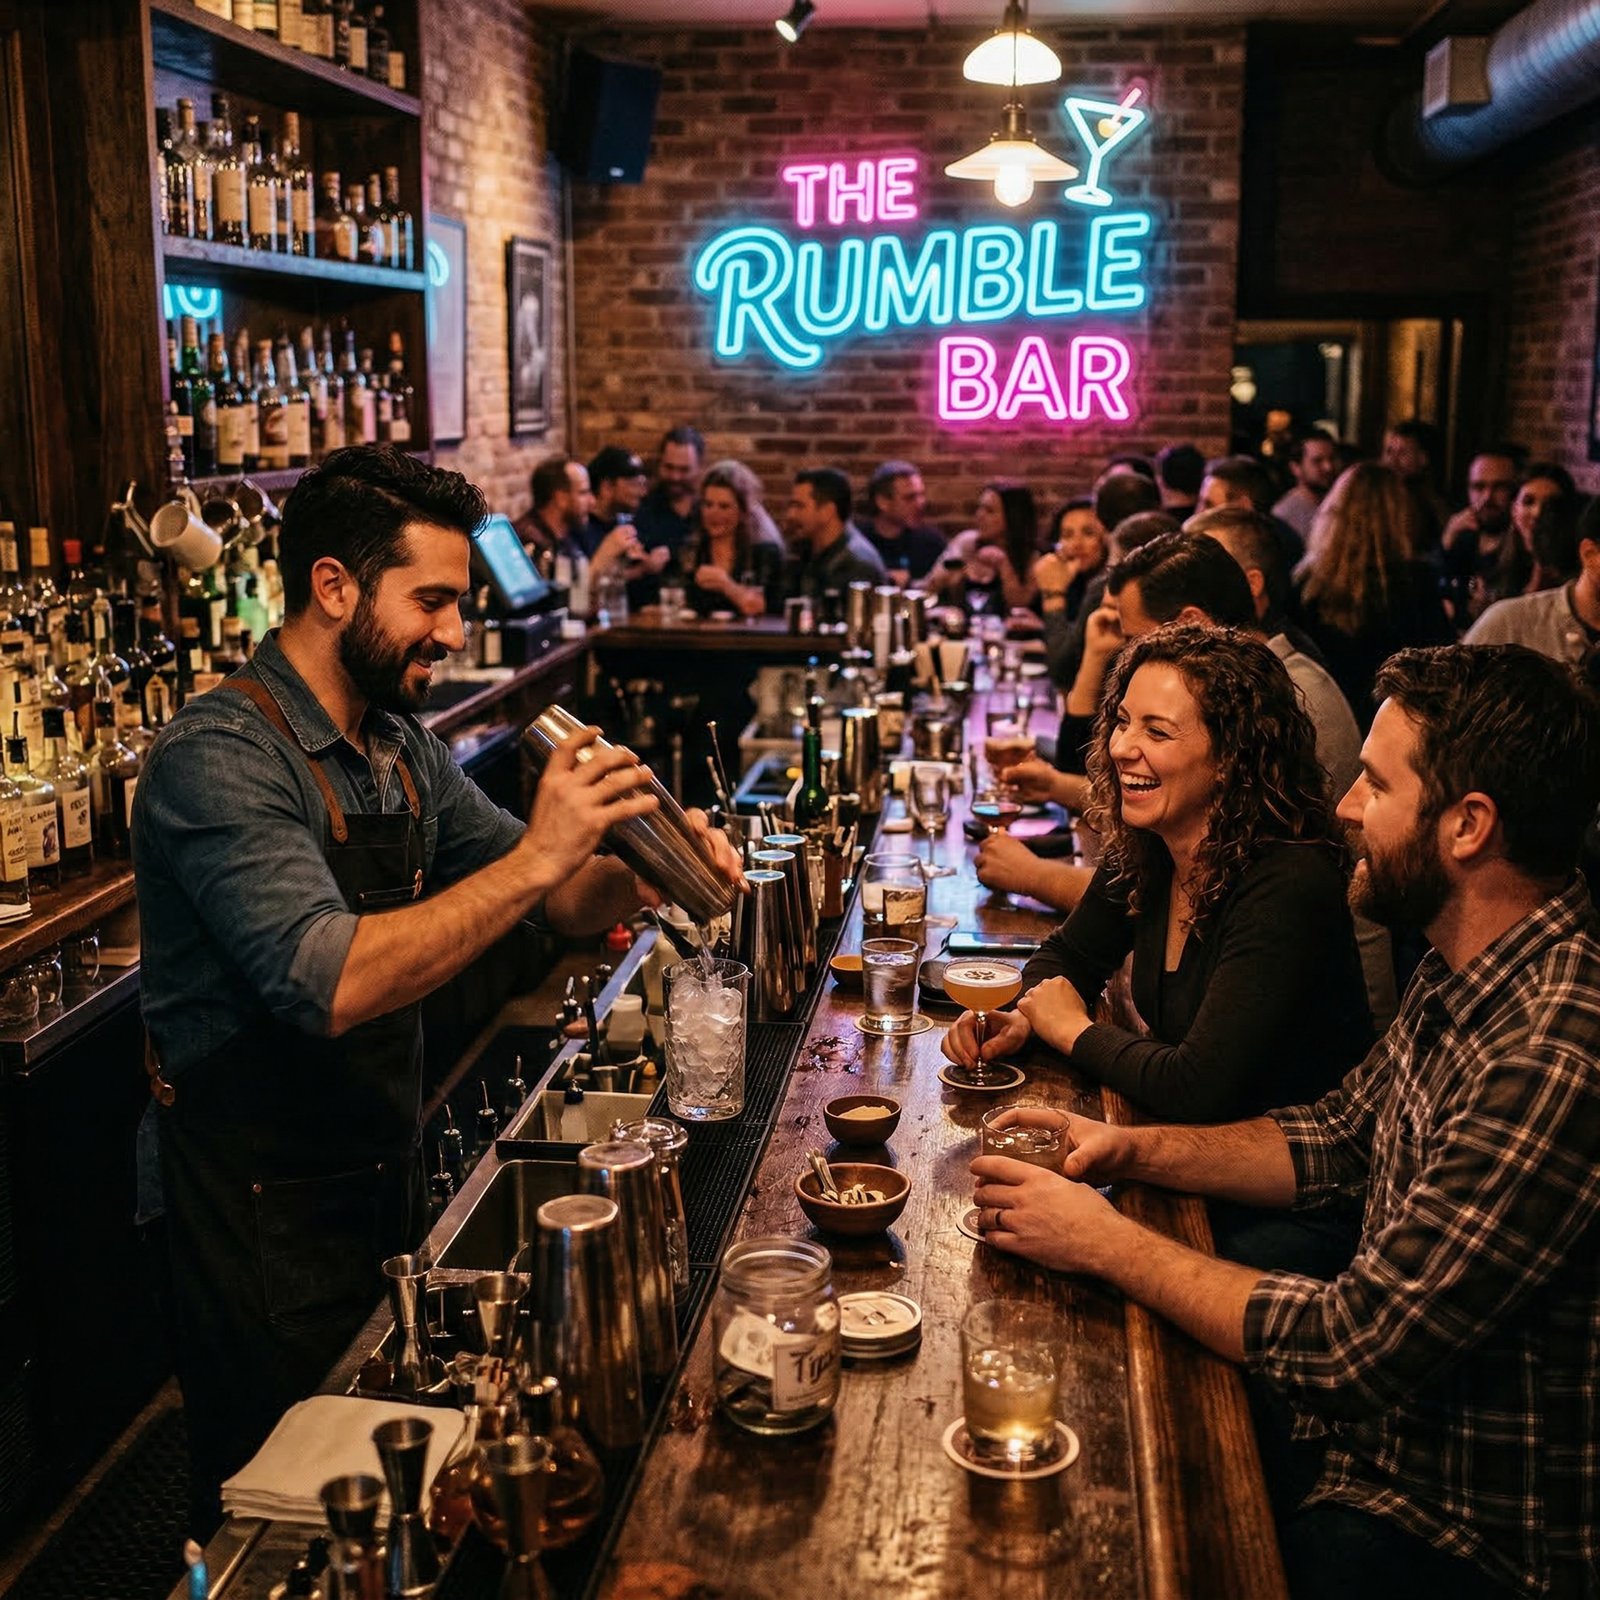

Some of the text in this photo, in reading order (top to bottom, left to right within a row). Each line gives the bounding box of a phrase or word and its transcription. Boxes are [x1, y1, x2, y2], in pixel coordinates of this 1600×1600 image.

[783, 158, 917, 227] THE
[695, 213, 1150, 366] RUMBLE
[938, 336, 1130, 420] BAR
